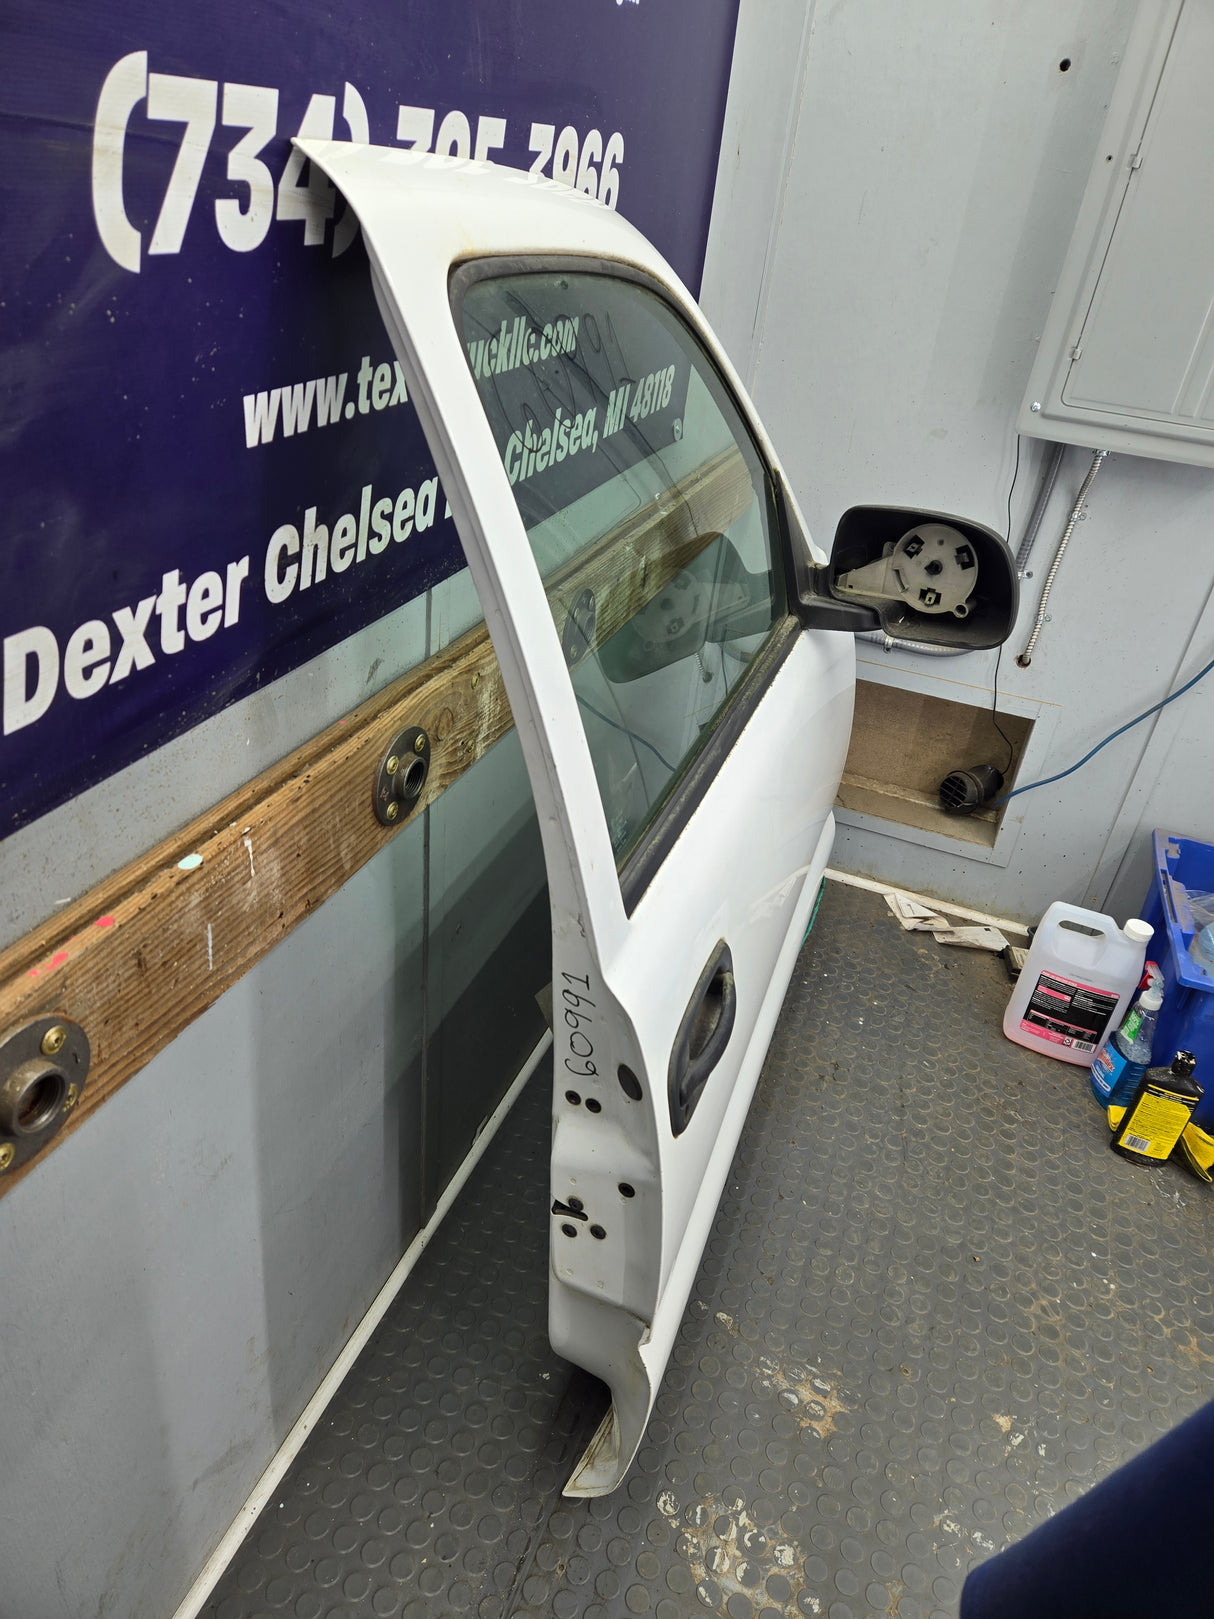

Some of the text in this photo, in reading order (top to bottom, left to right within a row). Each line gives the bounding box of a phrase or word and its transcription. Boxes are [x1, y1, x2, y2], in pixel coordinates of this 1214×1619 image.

[3, 364, 676, 736] Dexter Chelsea Chelsea, MI 48118
[561, 972, 599, 1077] 60991
